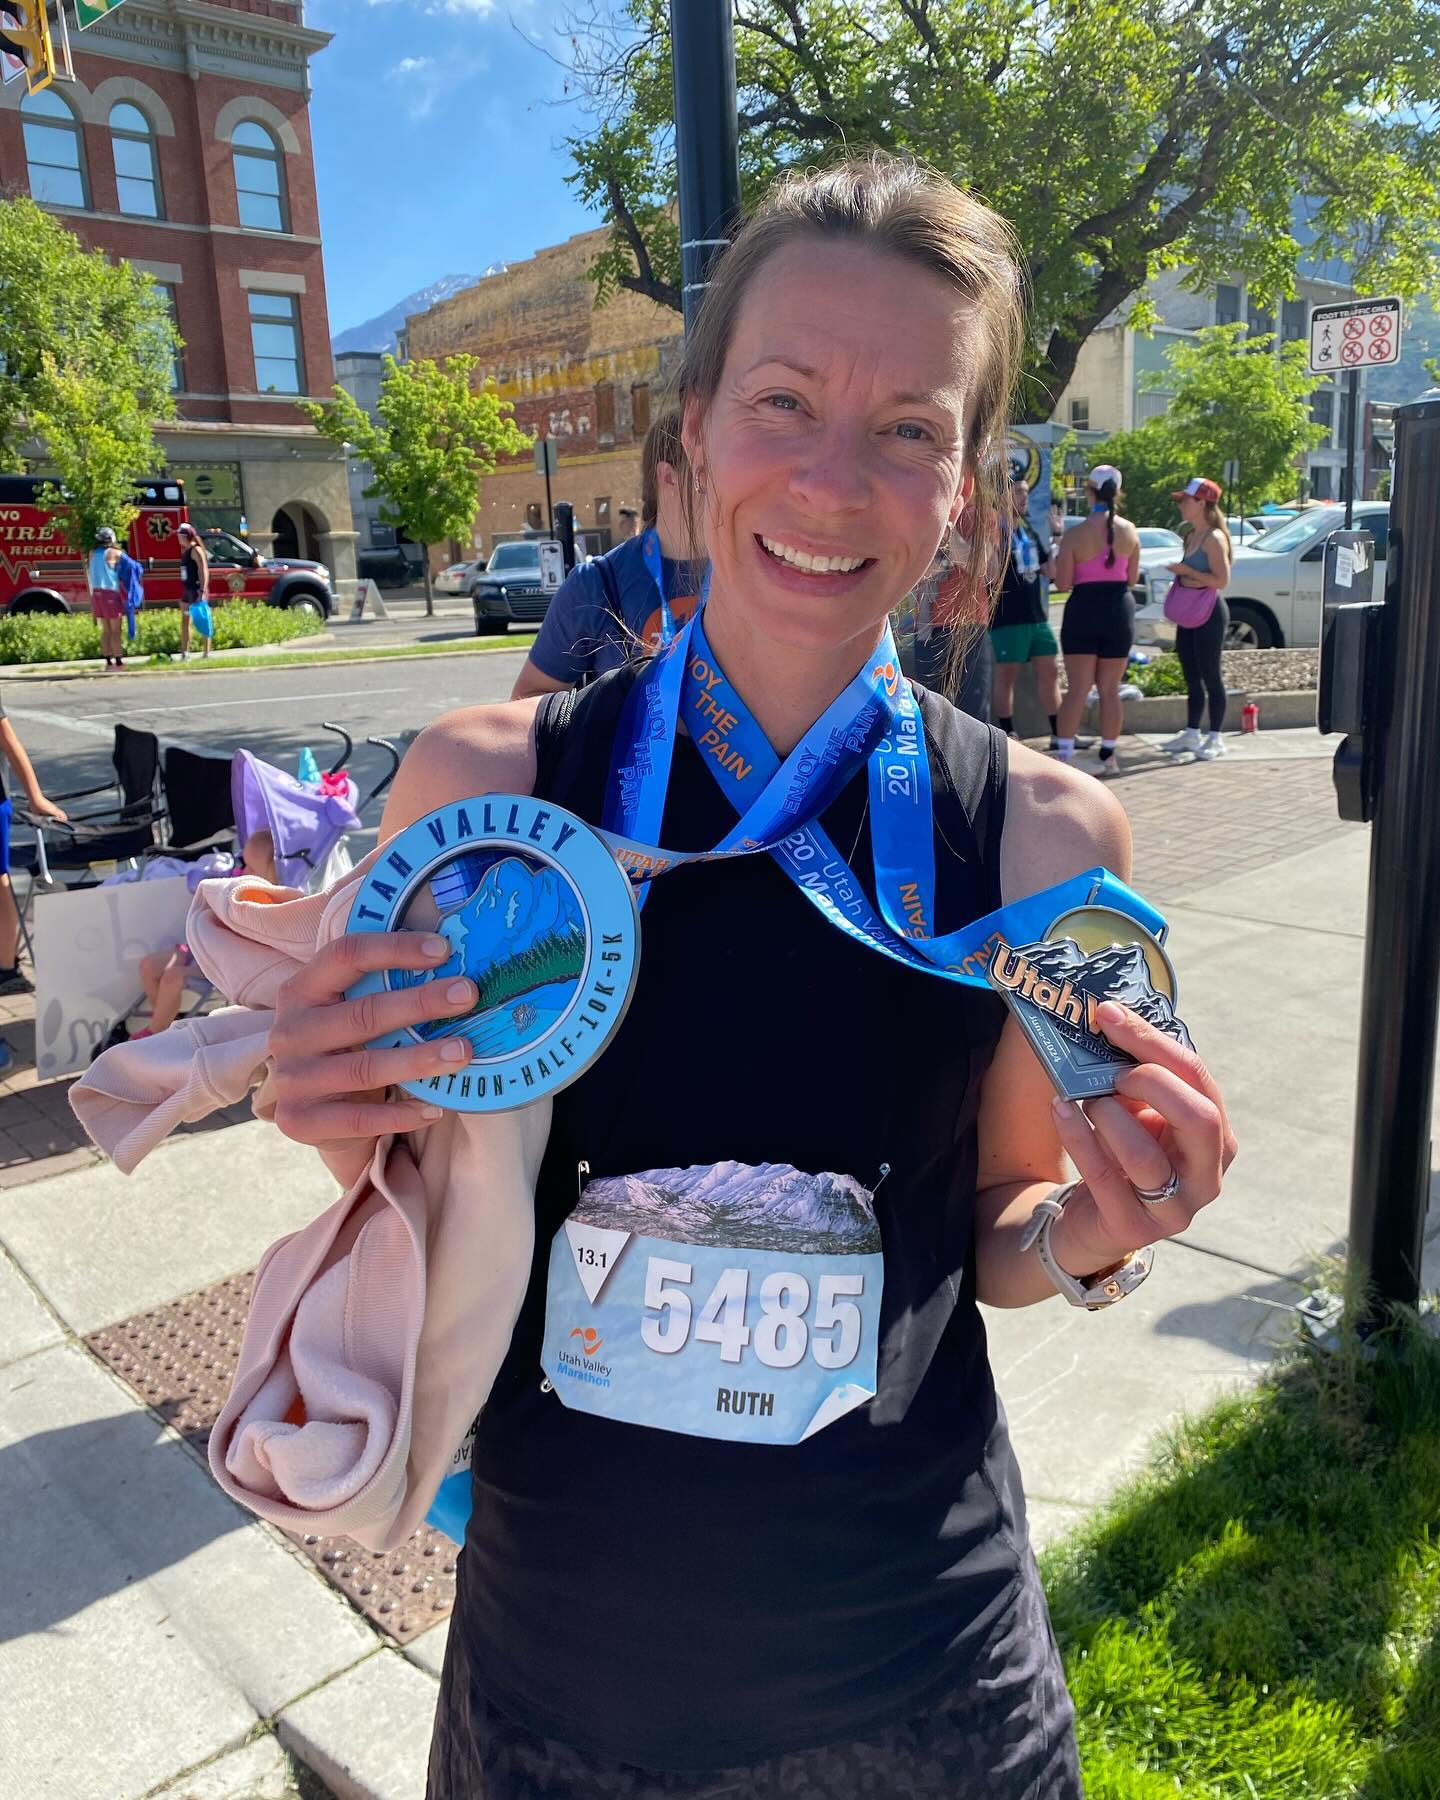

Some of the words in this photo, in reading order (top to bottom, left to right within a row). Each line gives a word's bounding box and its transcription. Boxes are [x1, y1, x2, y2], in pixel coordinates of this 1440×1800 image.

[1316, 311, 1338, 321] FOOT
[1339, 308, 1371, 318] TRAFFIC
[1371, 304, 1394, 314] ONLY
[0, 526, 55, 541] IRE
[645, 680, 668, 742] ENJOY
[694, 689, 739, 736] THE
[845, 704, 879, 754] PAIN
[633, 737, 654, 779] THE
[698, 728, 753, 781] PAIN
[820, 725, 848, 765] THE
[618, 765, 639, 816] PAIN
[783, 745, 819, 815] ENJOY
[886, 764, 911, 797] 20
[358, 851, 413, 922] TAH
[426, 803, 578, 854] VALLEY
[822, 861, 863, 916] Utah
[899, 883, 931, 941] PAIN
[992, 943, 1084, 1026] Utah
[1028, 1015, 1062, 1063] June-2024
[1056, 1021, 1114, 1063] Marathon
[576, 1247, 607, 1269] 13.1
[640, 1256, 864, 1369] 5485
[557, 1362, 610, 1388] Marathon
[558, 1351, 581, 1367] Utah
[583, 1357, 612, 1377] Valley
[716, 1388, 775, 1417] RUTH
